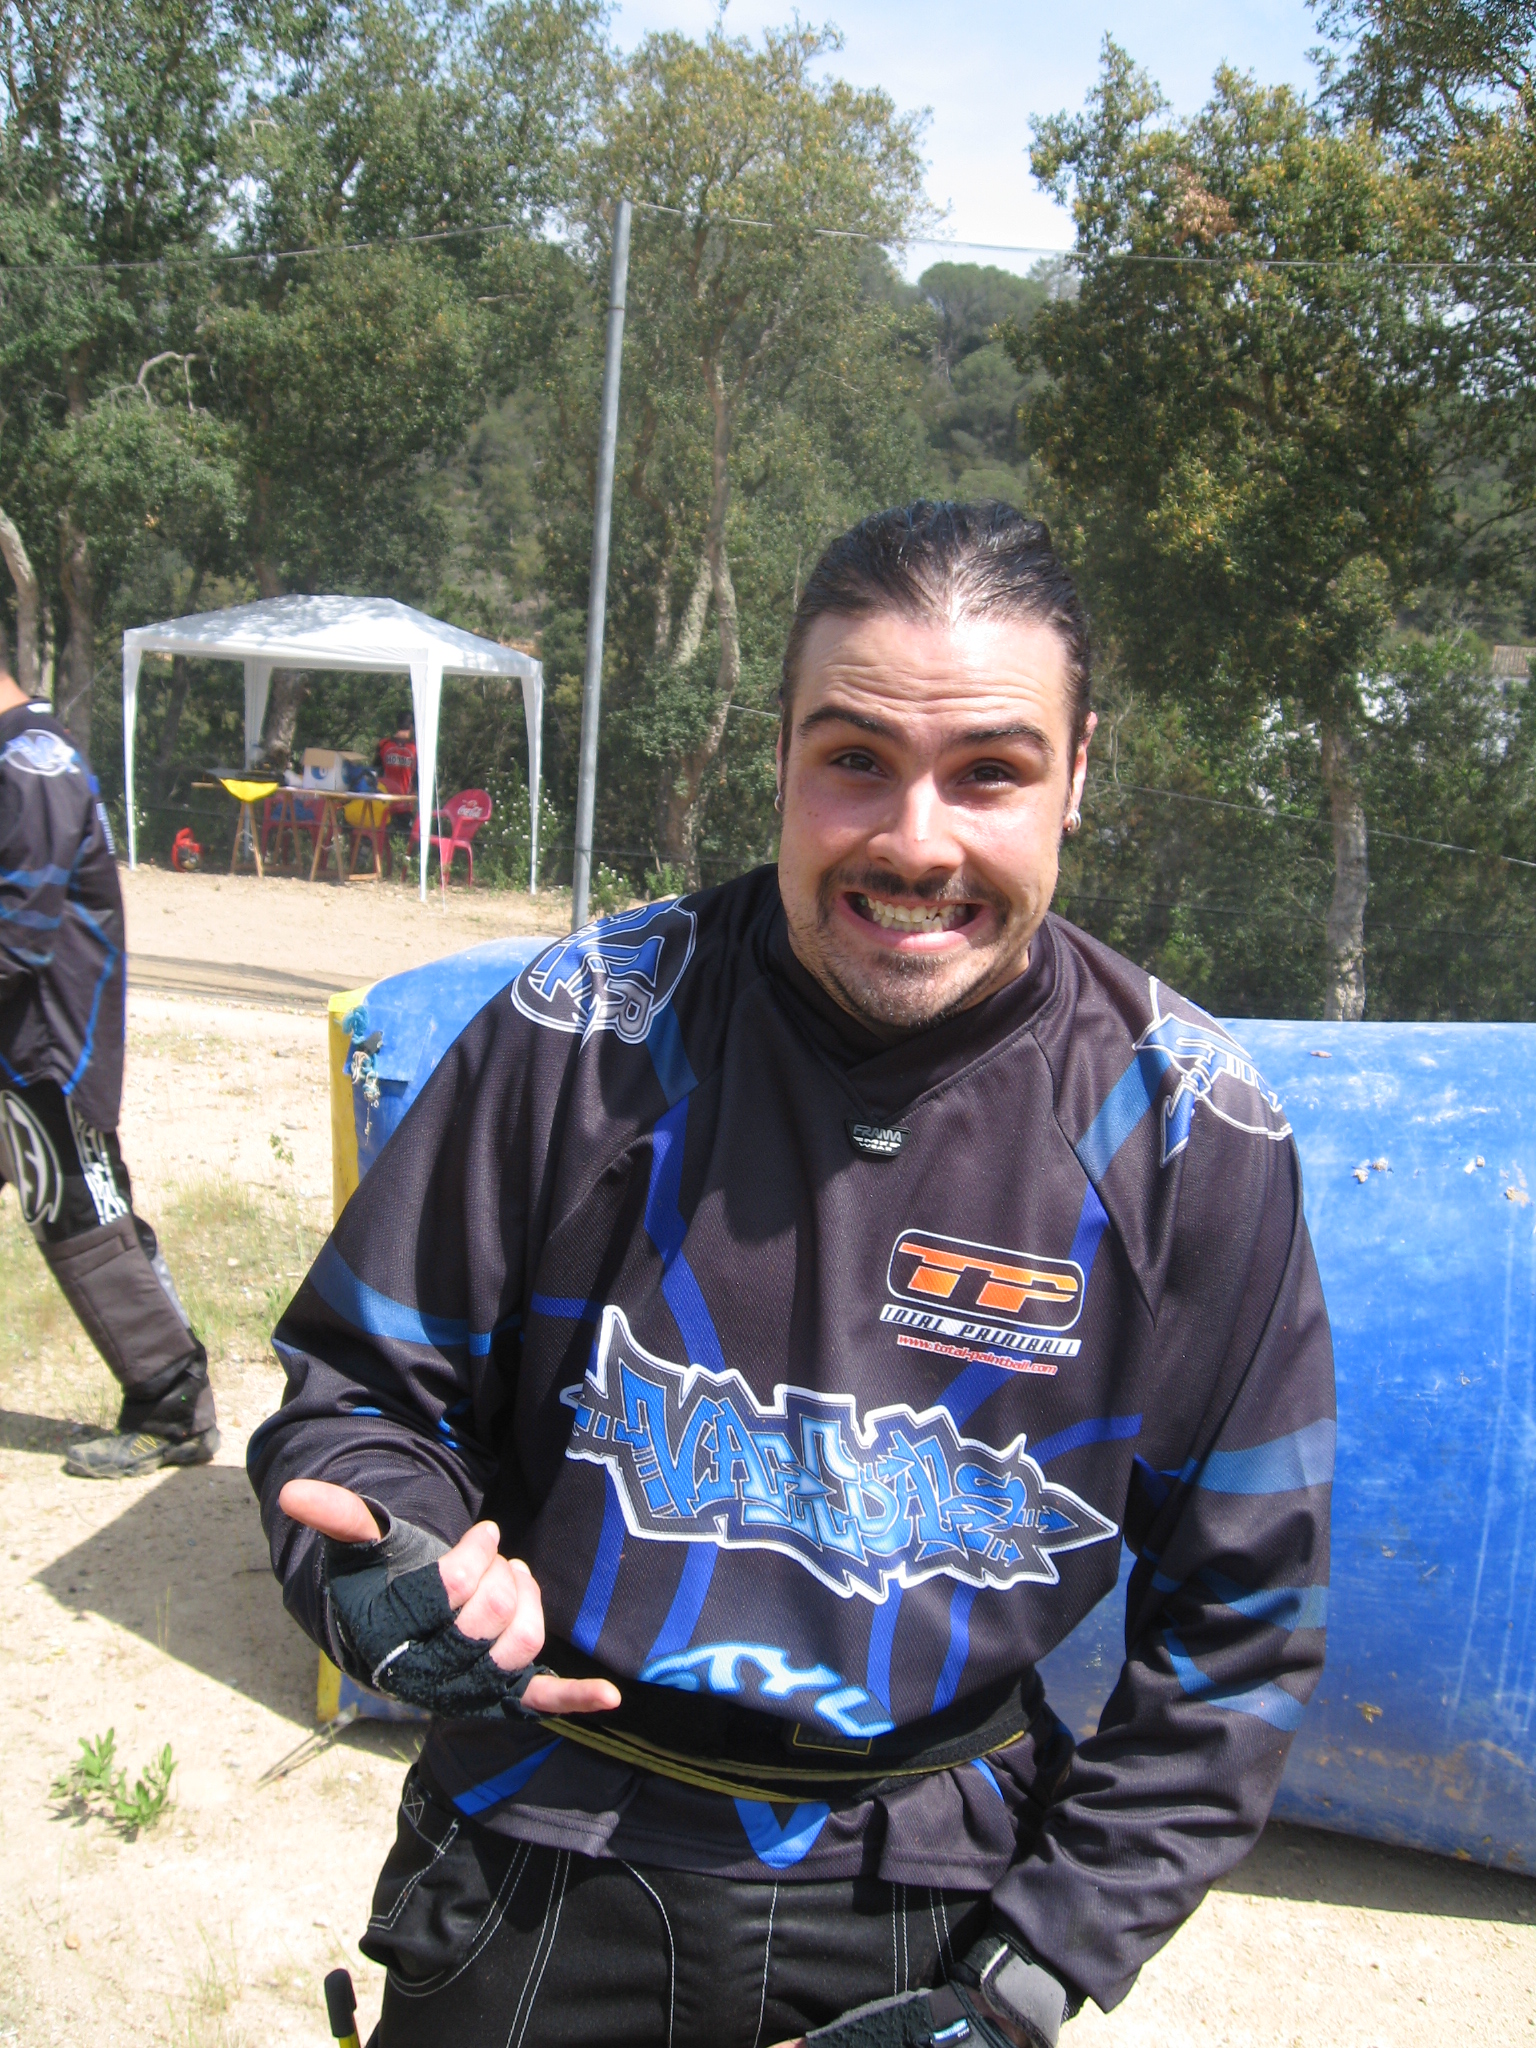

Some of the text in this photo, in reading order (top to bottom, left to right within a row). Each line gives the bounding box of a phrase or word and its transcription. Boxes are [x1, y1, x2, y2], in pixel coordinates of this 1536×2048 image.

[882, 1305, 1080, 1357] TOTAL PAINTBALL
[896, 1333, 1058, 1376] www.total-paintball.com
